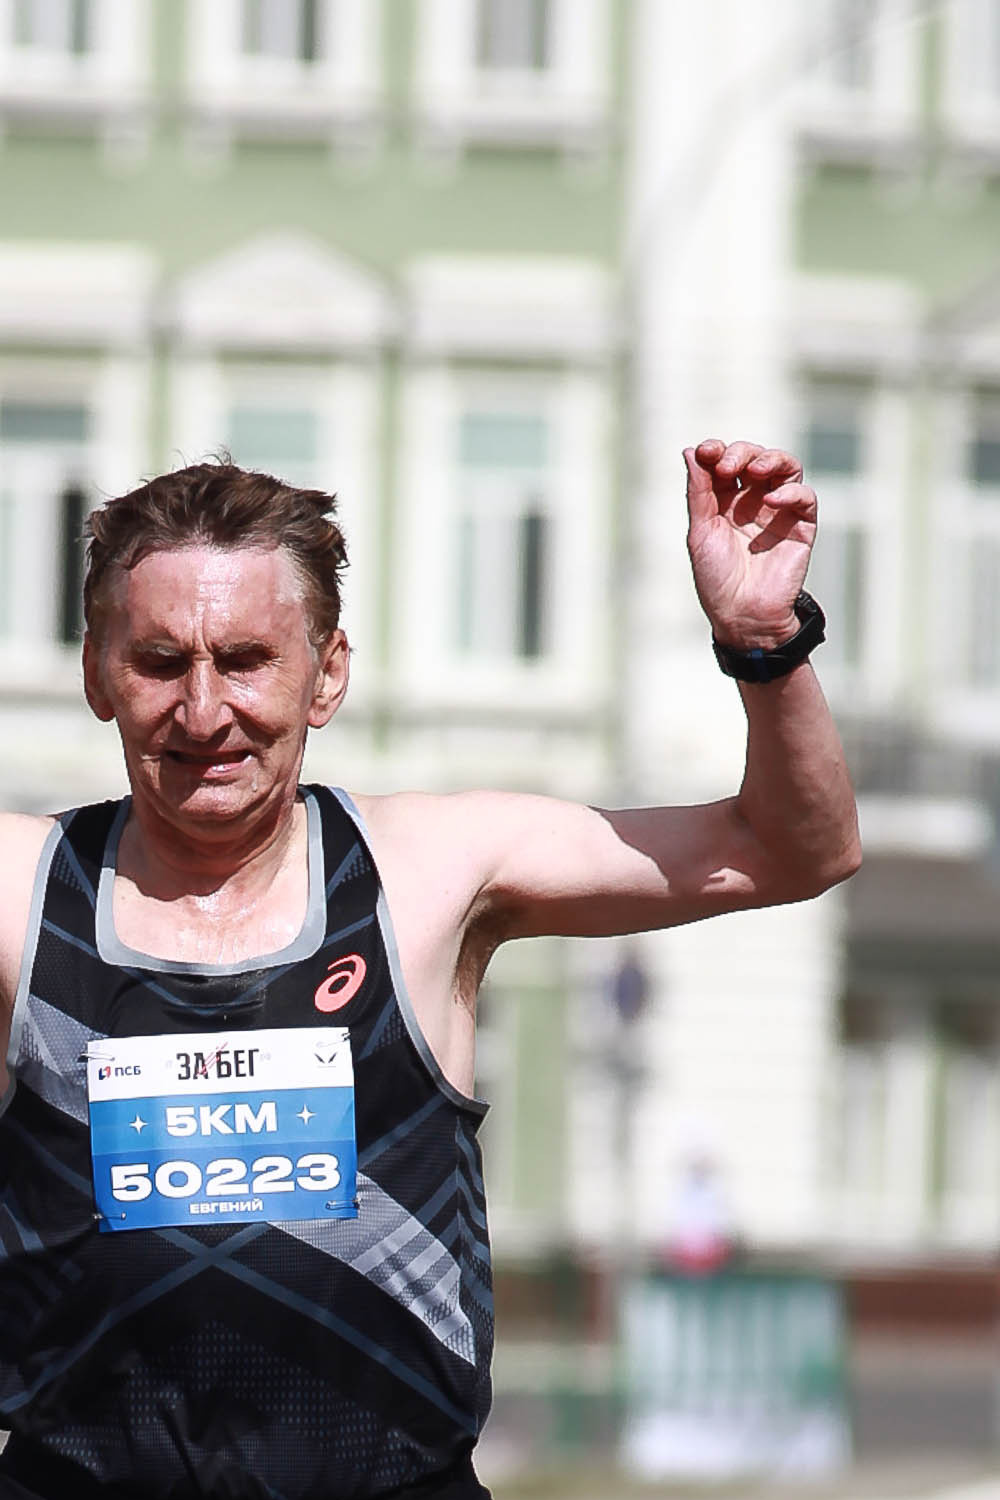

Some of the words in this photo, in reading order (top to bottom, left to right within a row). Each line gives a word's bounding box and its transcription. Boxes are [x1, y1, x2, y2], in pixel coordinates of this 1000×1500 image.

[114, 1065, 142, 1077] ПСБ
[110, 1153, 341, 1202] 50223
[189, 1198, 263, 1215] ЕВГЕНИЙ
